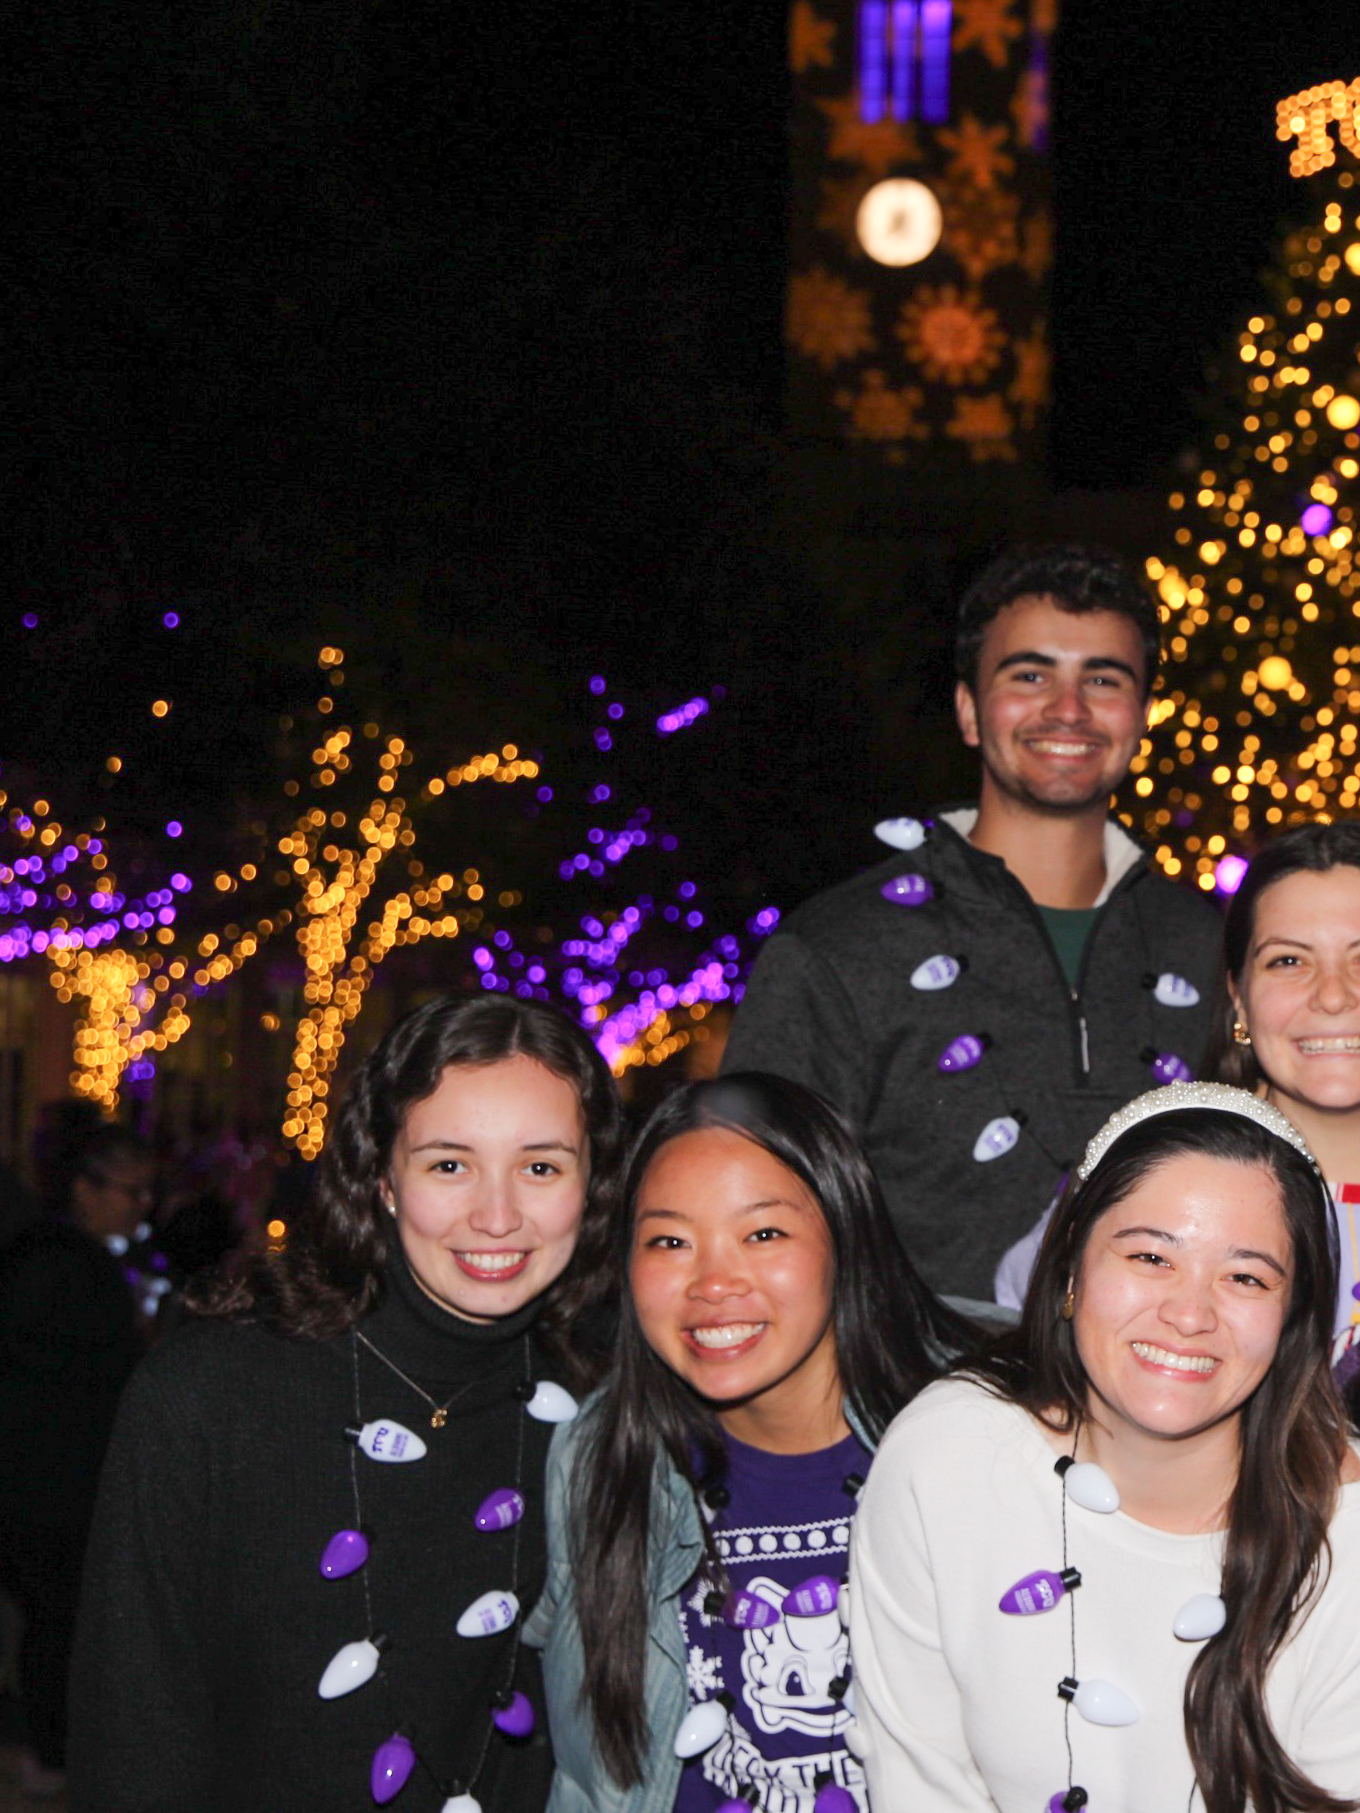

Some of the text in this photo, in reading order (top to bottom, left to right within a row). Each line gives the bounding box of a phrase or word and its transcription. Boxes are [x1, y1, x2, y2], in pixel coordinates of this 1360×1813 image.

[372, 1427, 389, 1453] TCU
[815, 1582, 833, 1610] TCU
[1035, 1578, 1055, 1608] TCU
[734, 1597, 751, 1625] TCU
